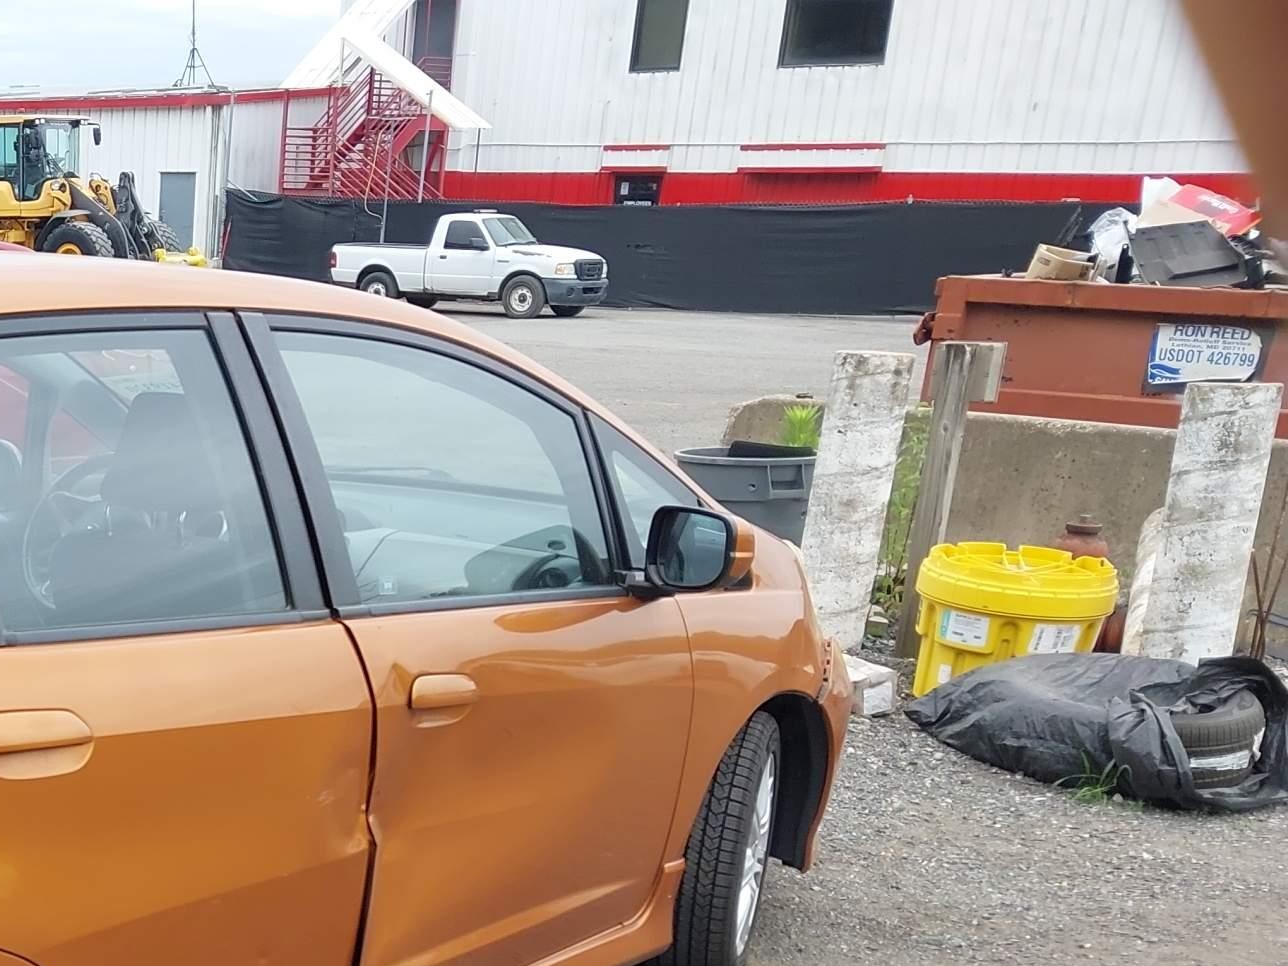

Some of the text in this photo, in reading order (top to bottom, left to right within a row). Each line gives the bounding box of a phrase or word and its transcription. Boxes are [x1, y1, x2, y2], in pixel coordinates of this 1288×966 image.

[1173, 324, 1252, 340] RON REED
[1158, 347, 1255, 367] USDOT 426799
